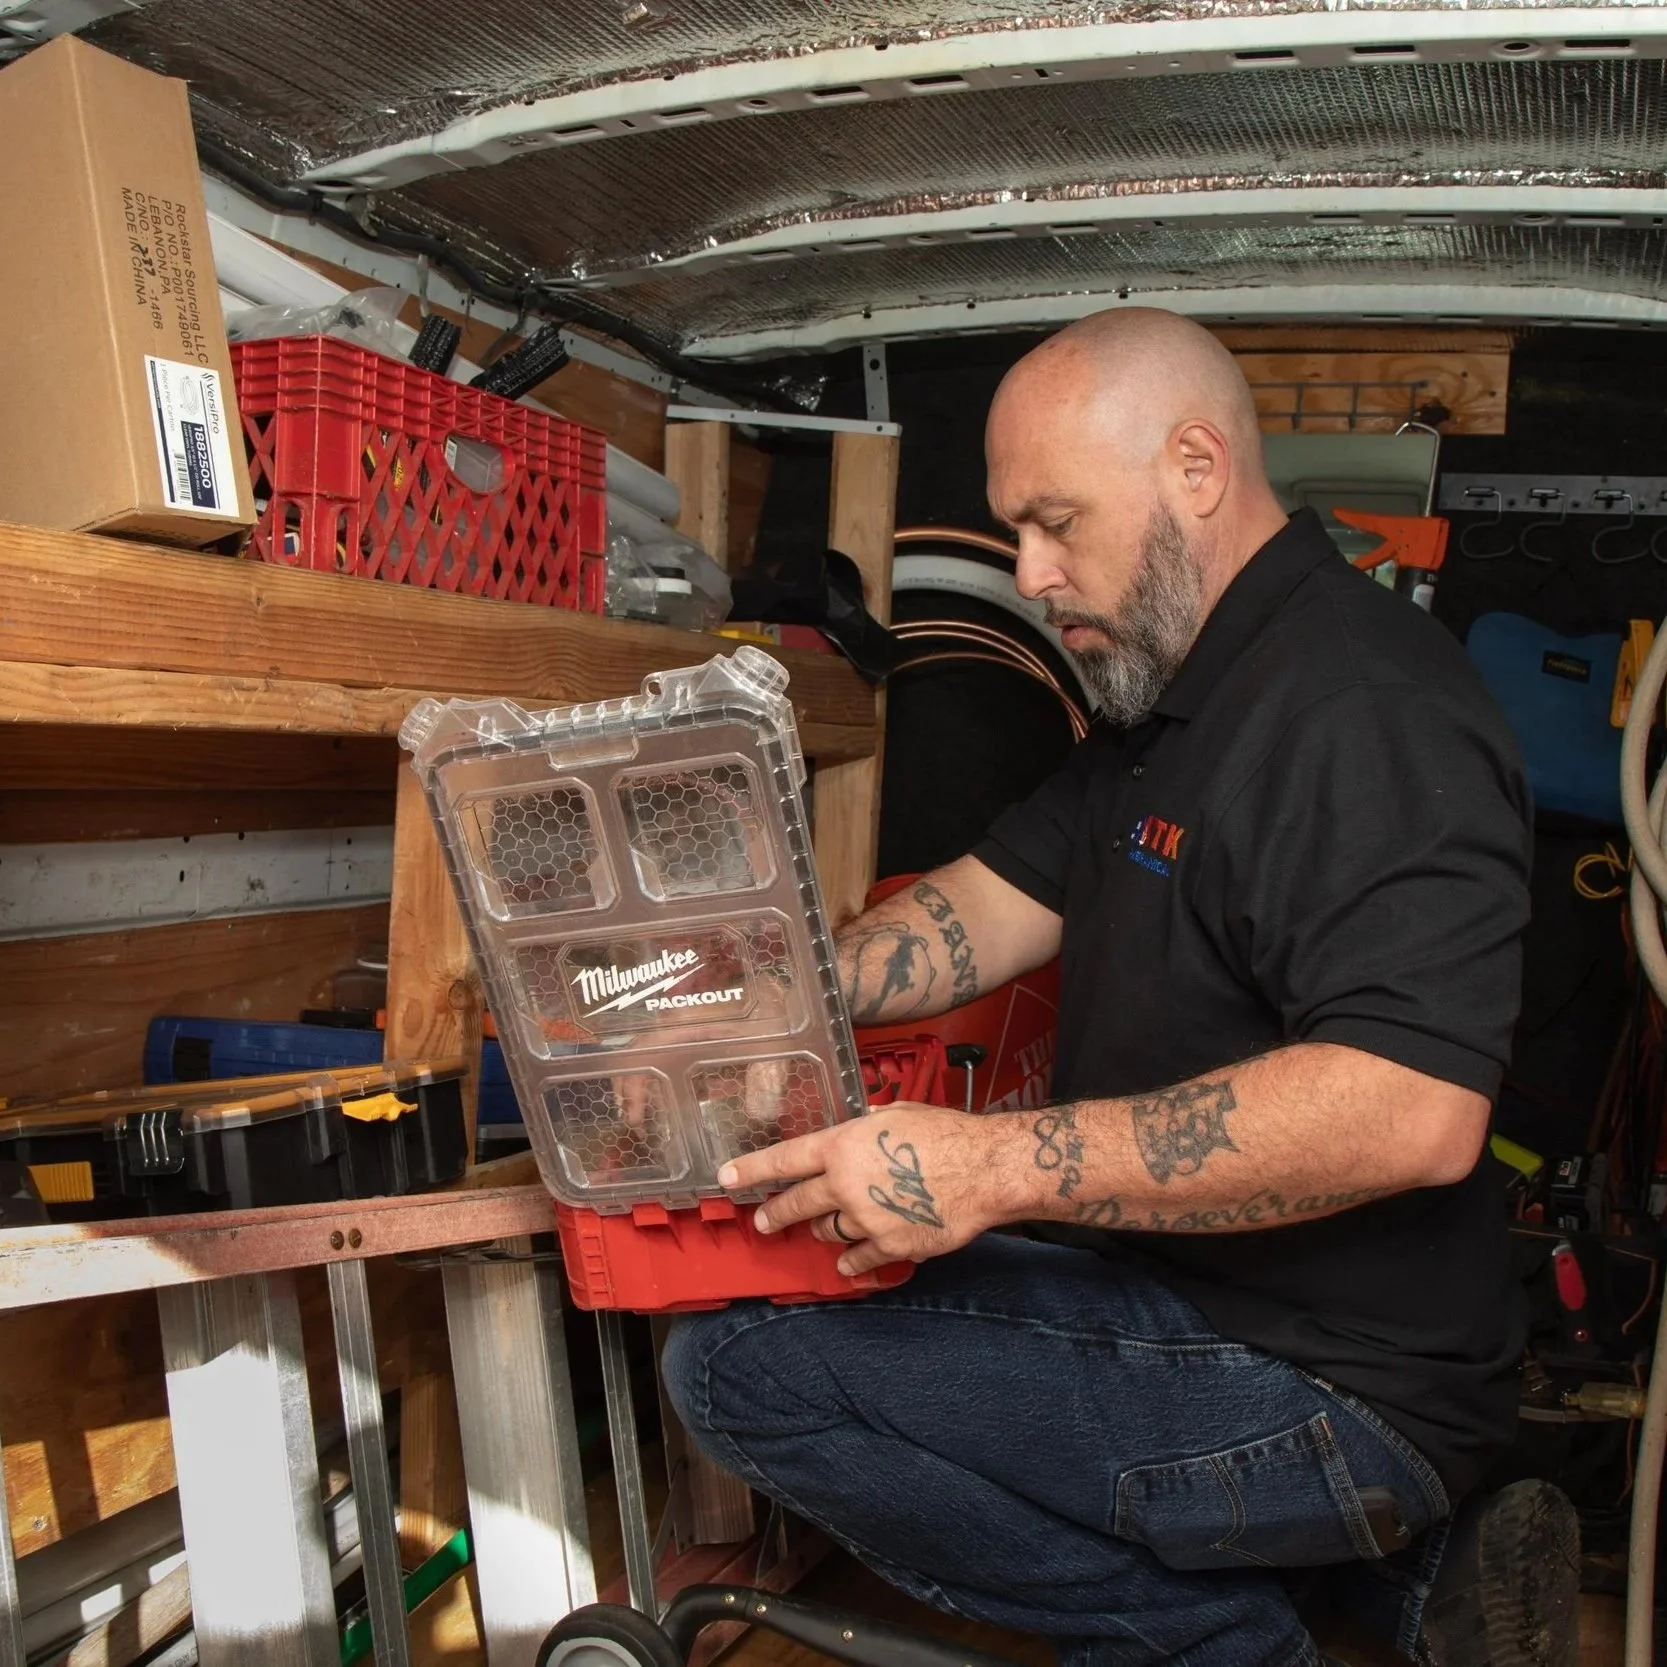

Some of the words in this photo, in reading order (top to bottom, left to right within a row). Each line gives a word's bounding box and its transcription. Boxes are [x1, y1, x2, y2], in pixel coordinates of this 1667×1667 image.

[122, 187, 138, 234] MADE
[162, 200, 174, 227] P/O
[129, 237, 141, 253] IN
[131, 257, 147, 305] CHINA
[175, 203, 193, 266] Rockstar
[185, 269, 201, 331] Sourcing
[194, 336, 208, 363] LLC
[206, 383, 220, 435] VersiPro
[194, 426, 211, 489] 1882500
[570, 949, 699, 1005] Milwaukee
[645, 987, 743, 1011] PACKOUT
